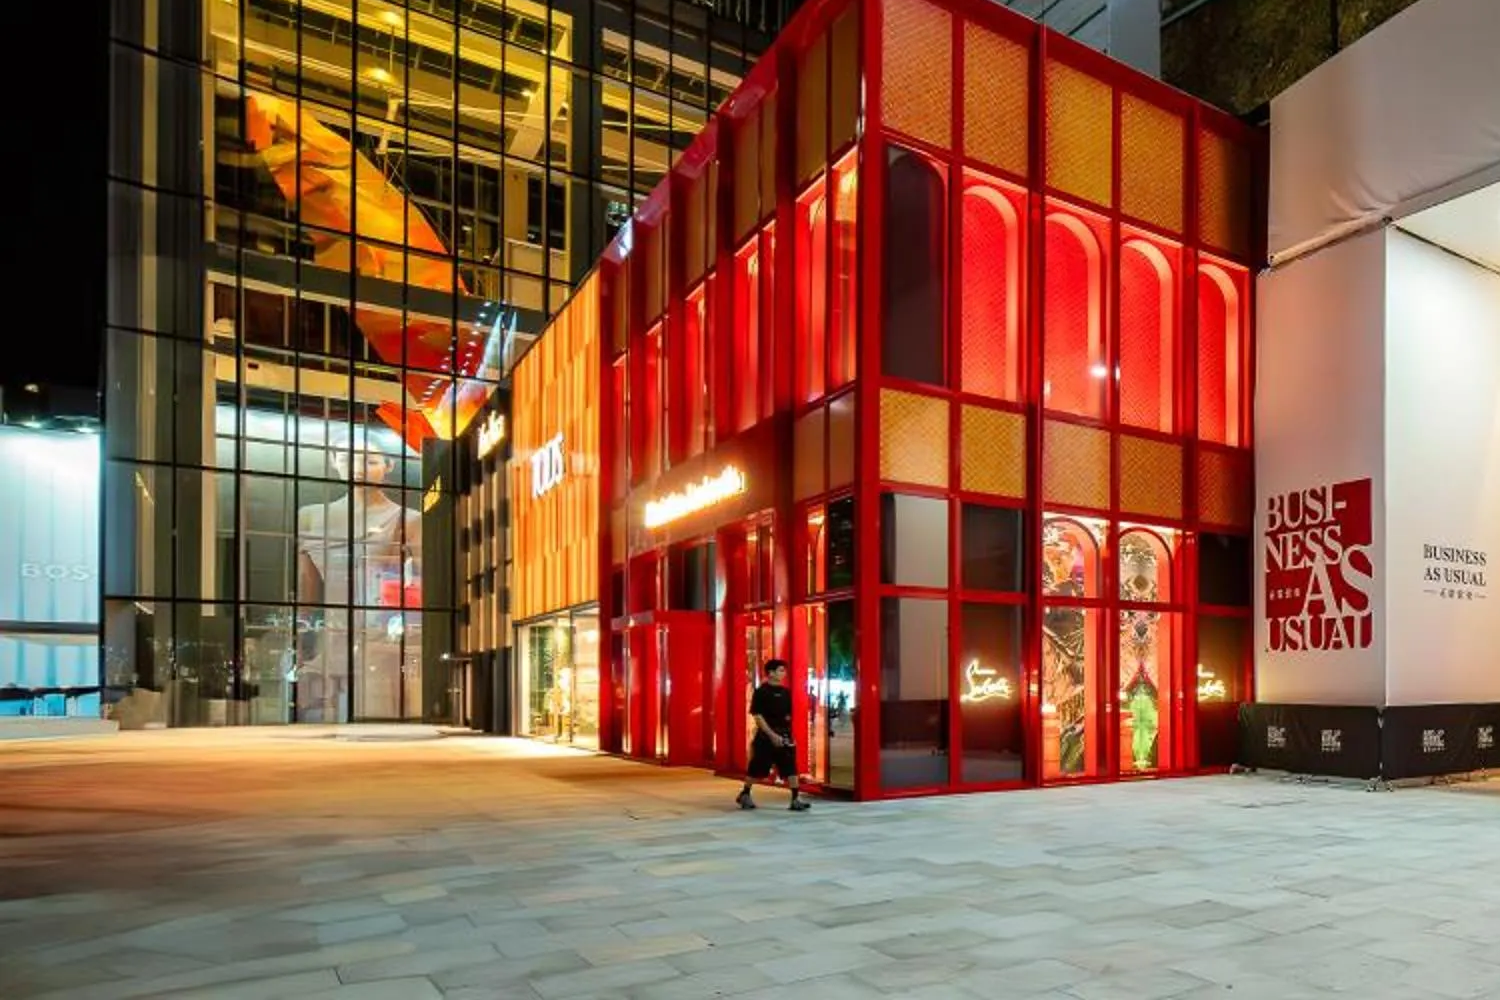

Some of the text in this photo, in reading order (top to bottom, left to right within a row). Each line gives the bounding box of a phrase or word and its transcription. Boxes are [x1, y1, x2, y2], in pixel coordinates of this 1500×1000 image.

[1265, 483, 1348, 533] BUSI-
[1265, 525, 1344, 573] NESS
[1423, 543, 1487, 567] BUSINESS
[1300, 542, 1375, 617] AS
[1423, 567, 1487, 587] AS USUAL
